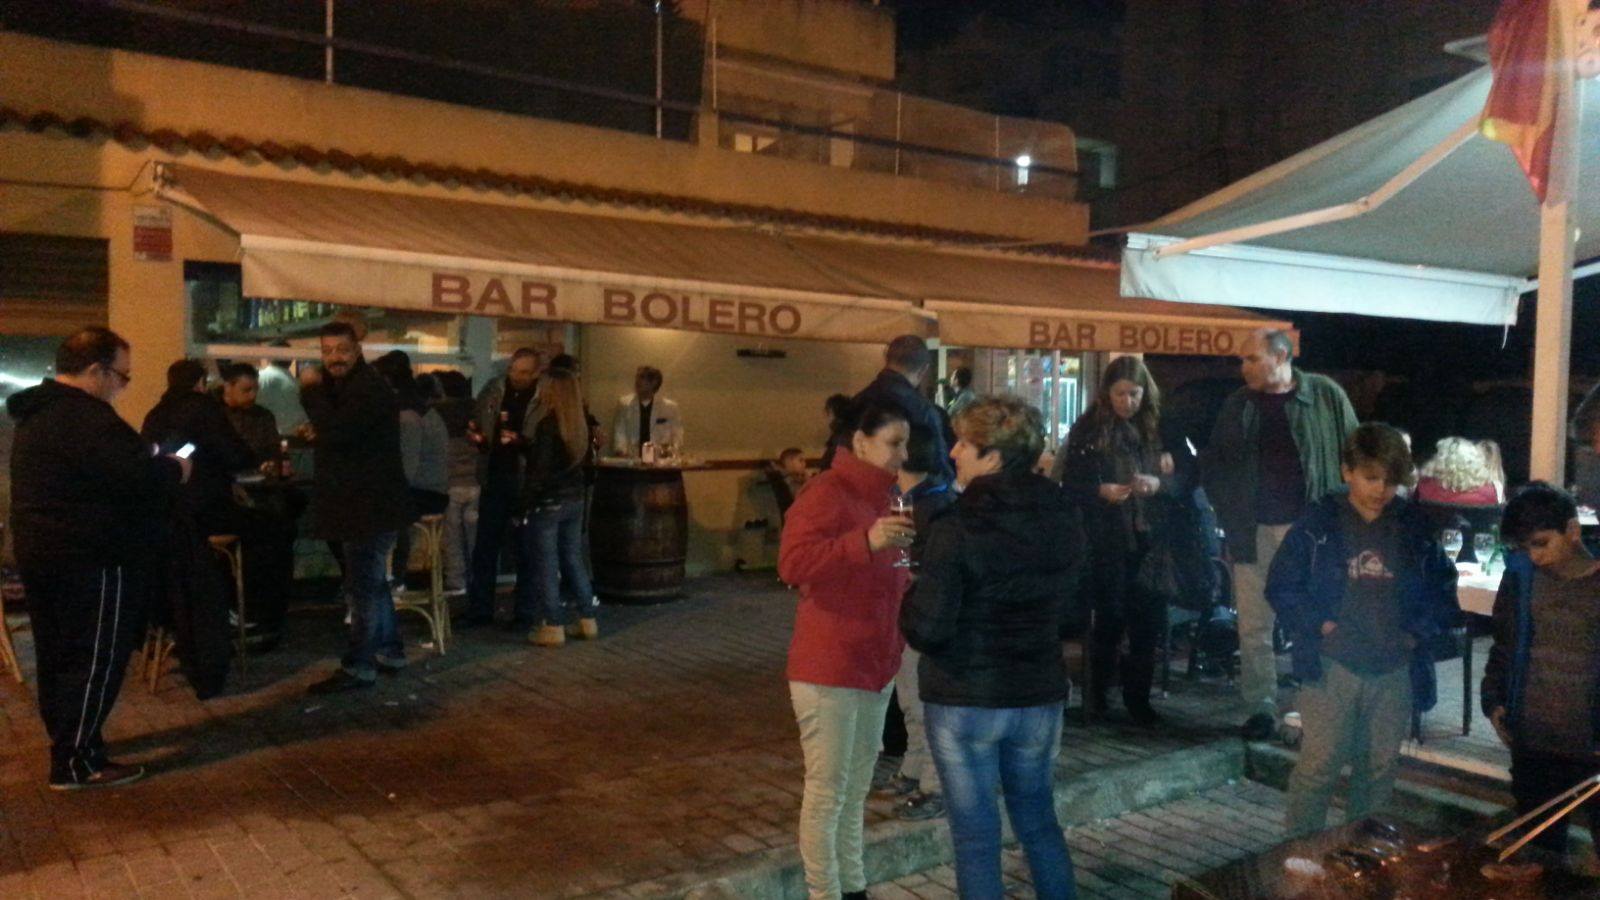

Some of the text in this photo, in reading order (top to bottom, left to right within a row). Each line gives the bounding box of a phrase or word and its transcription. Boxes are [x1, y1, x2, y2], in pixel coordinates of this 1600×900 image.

[431, 273, 801, 335] BAR BOLERO
[1029, 320, 1233, 354] BAR BOLERO
